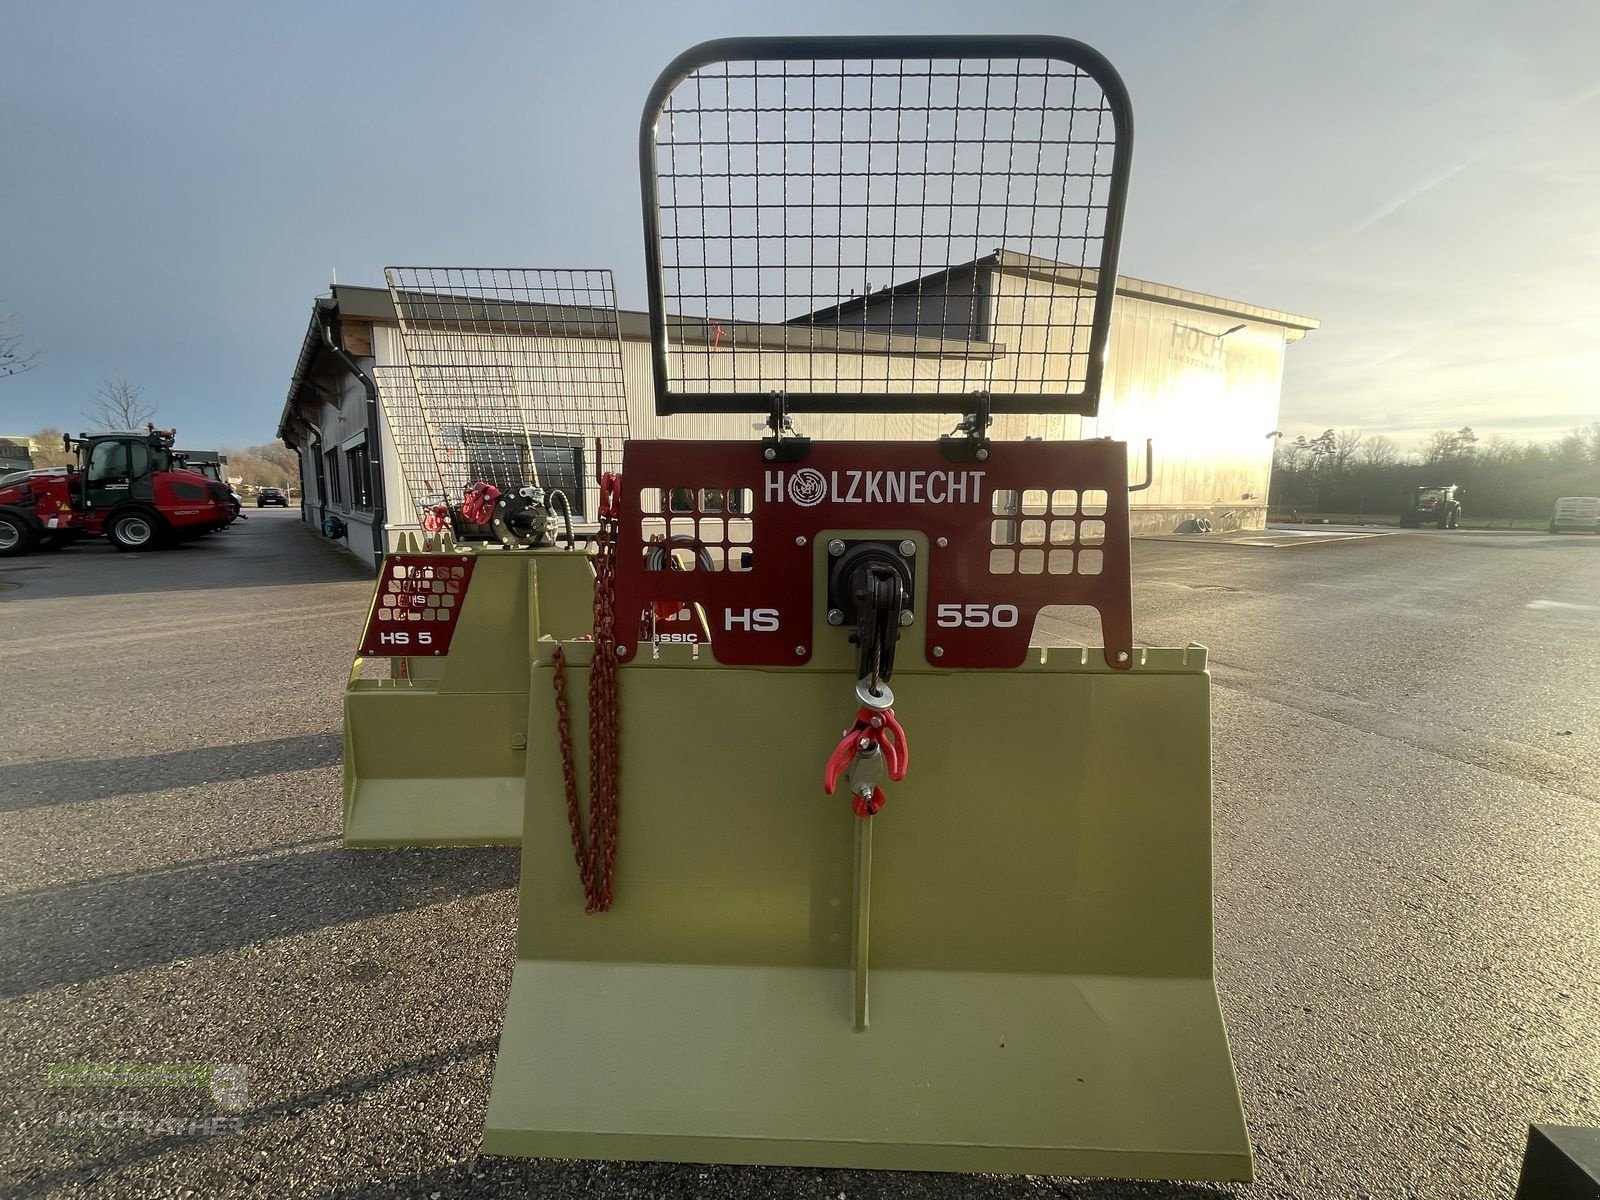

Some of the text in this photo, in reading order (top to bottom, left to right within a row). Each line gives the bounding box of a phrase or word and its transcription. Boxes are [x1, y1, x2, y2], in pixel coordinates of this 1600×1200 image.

[764, 467, 986, 507] HOLZKNECHT
[724, 607, 780, 632] HS
[937, 604, 1019, 628] 550
[380, 632, 433, 645] HS 5
